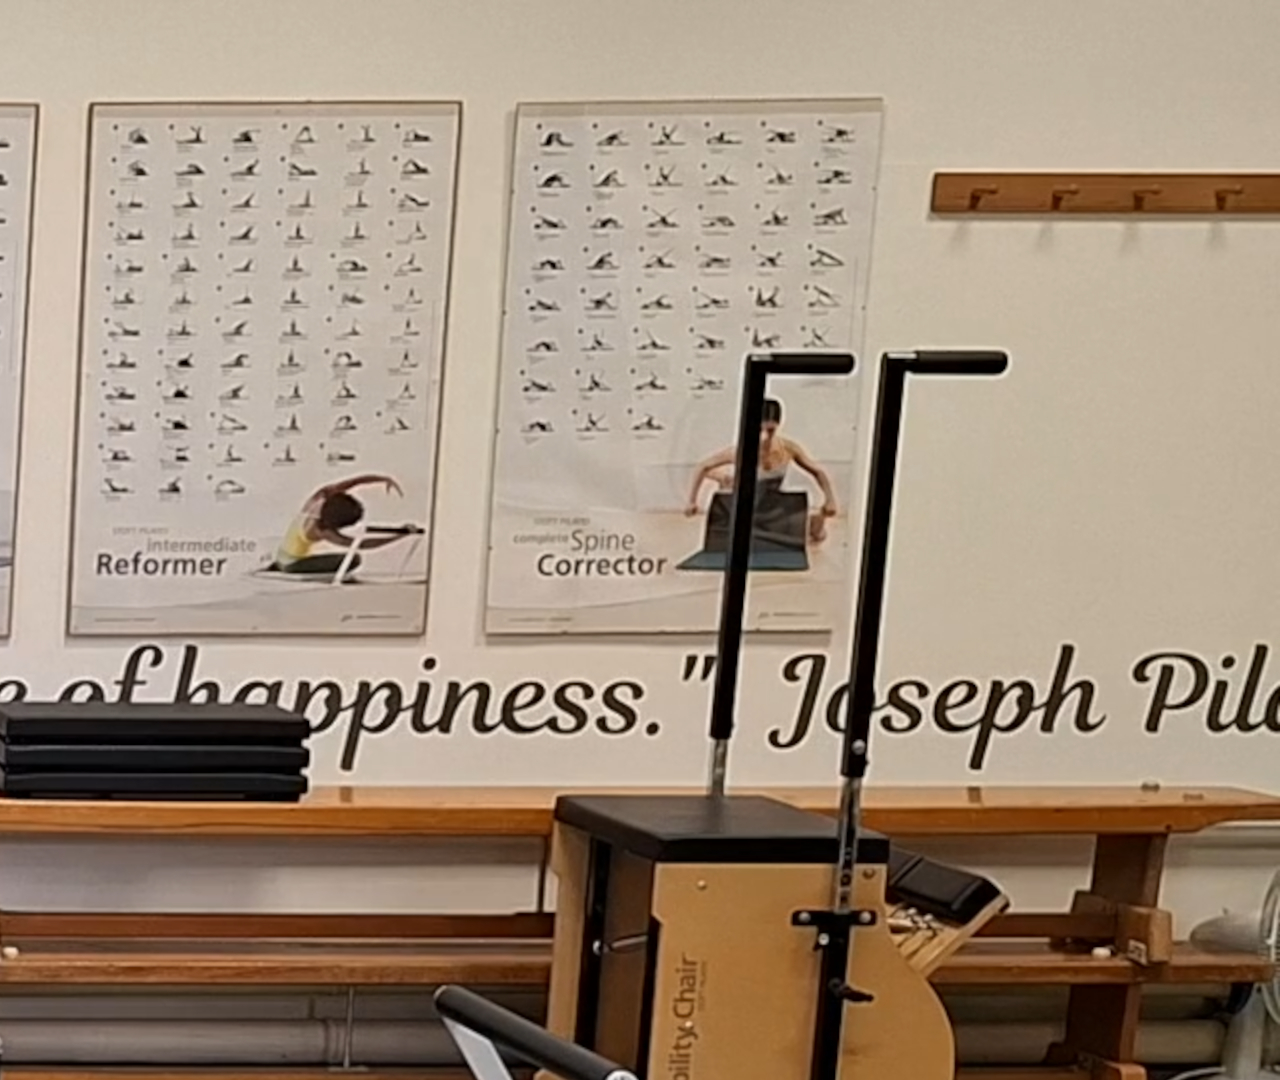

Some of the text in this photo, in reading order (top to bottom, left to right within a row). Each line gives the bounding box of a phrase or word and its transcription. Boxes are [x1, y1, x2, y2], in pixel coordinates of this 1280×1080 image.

[146, 537, 257, 553] intermediate
[571, 529, 635, 555] Spine
[96, 551, 228, 576] Reformer
[537, 553, 668, 577] Corrector
[671, 952, 698, 1018] Chair
